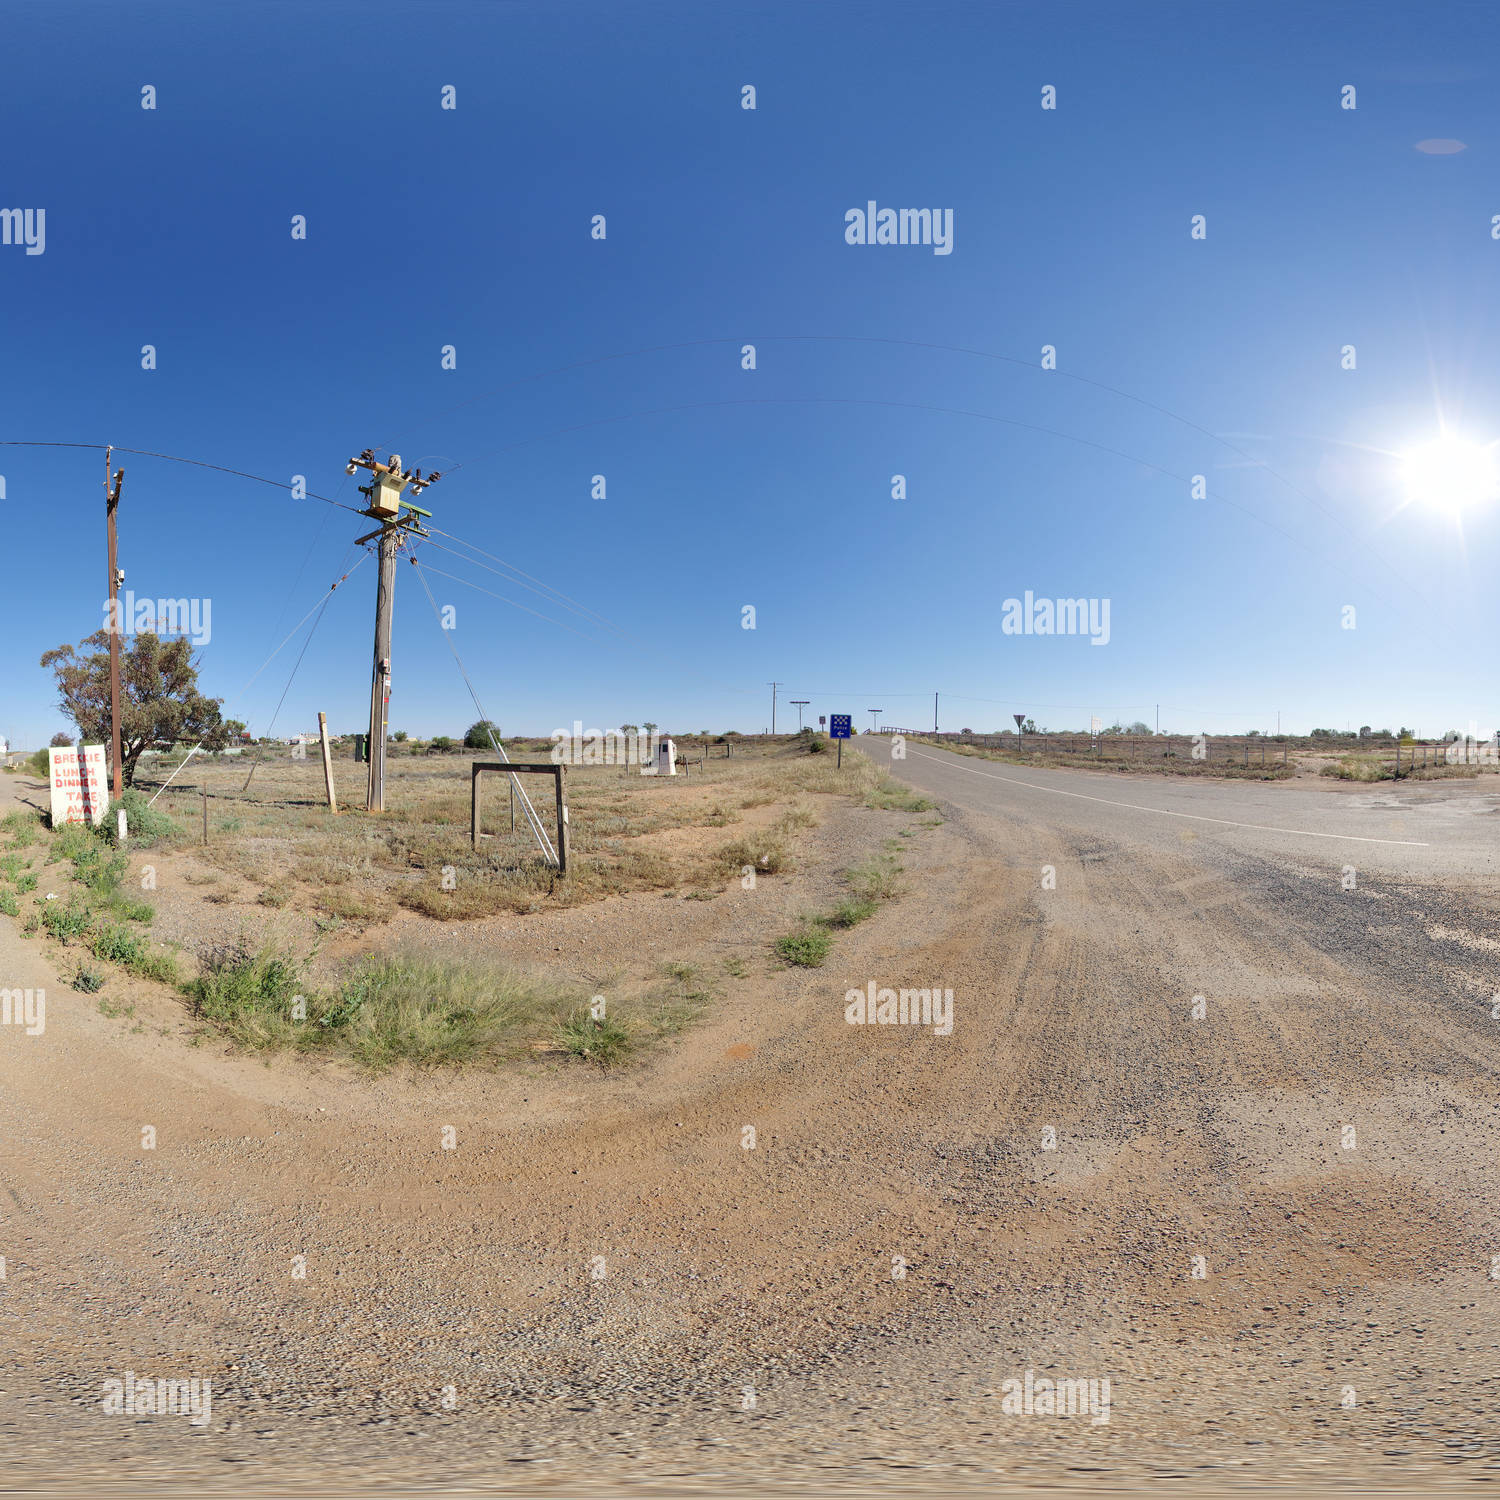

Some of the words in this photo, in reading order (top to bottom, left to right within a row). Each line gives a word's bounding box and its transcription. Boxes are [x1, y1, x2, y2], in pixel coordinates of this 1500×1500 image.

[54, 753, 100, 764] BREKKIE
[56, 768, 94, 778] LUNCH
[56, 778, 98, 788] DINNER
[66, 792, 97, 802] TAKE
[66, 804, 97, 814] AWAY
